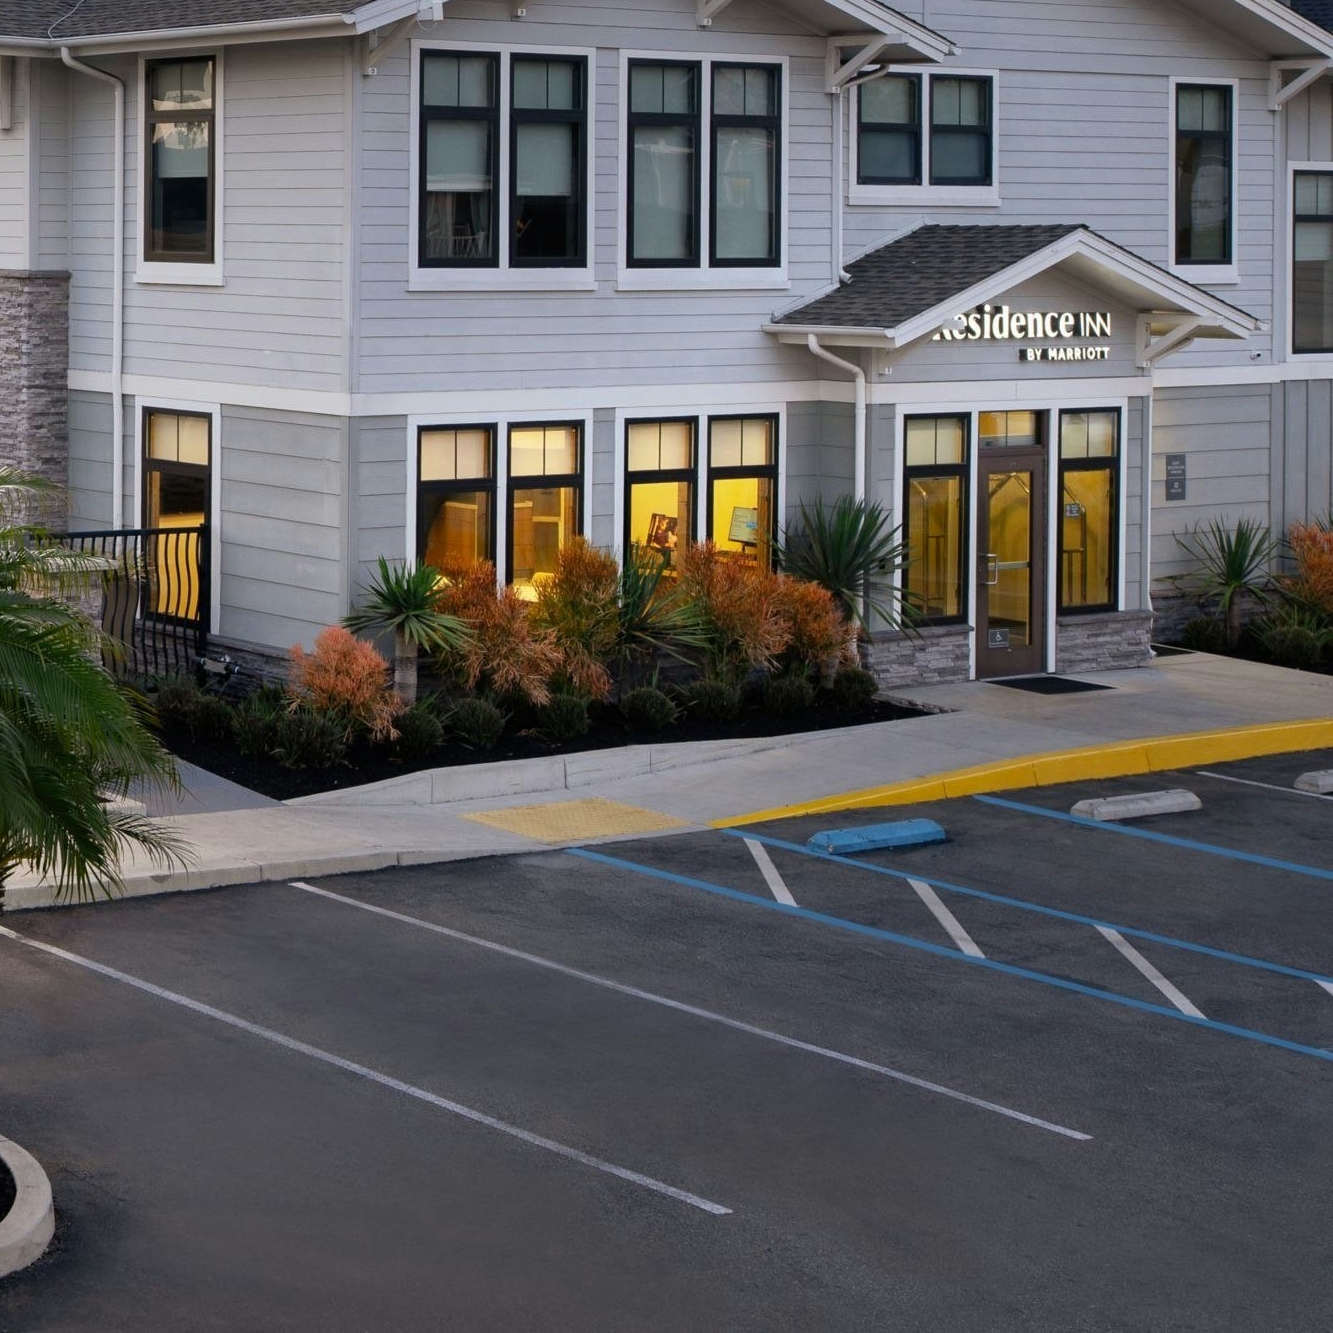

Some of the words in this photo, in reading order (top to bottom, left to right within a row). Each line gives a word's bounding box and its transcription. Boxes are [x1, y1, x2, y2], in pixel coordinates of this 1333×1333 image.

[1080, 312, 1111, 337] INN
[1026, 348, 1043, 361] BY
[1048, 346, 1111, 361] MARRIOTT
